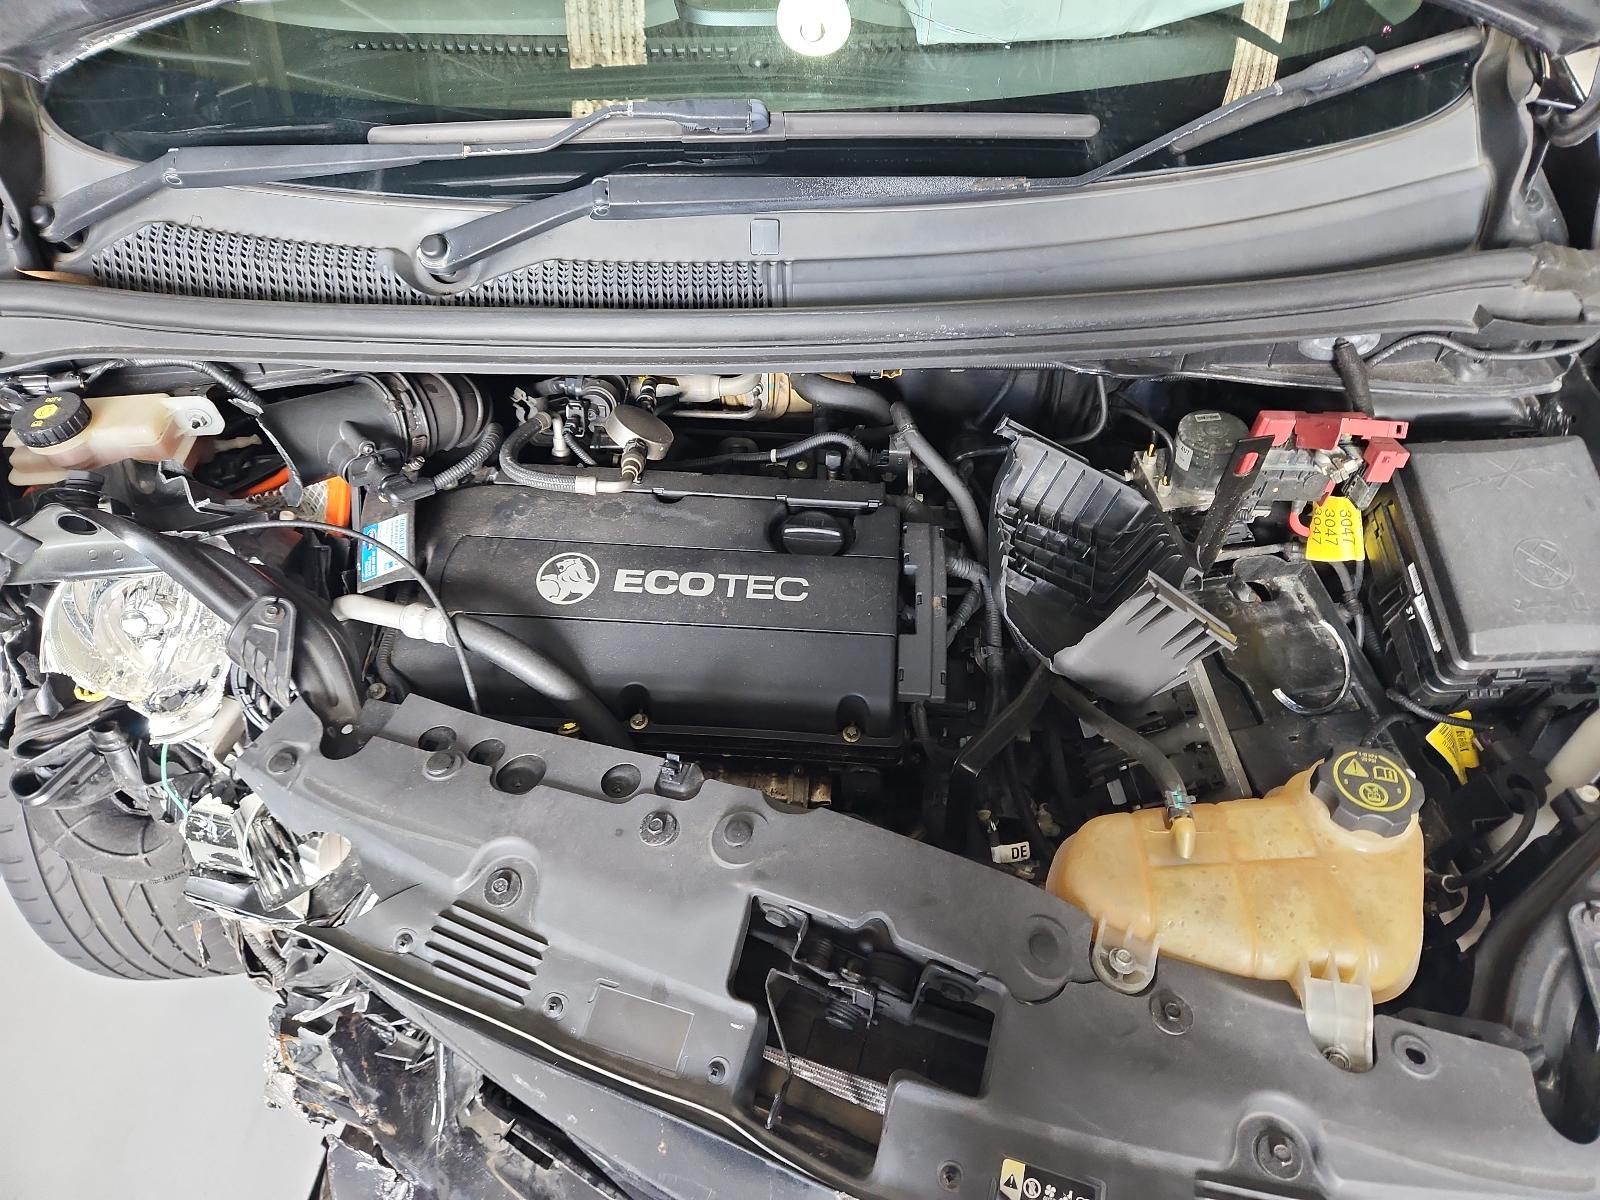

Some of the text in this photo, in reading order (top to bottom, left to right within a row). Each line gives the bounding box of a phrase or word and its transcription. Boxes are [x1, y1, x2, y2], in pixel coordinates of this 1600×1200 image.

[1312, 508, 1322, 545] 3047
[1325, 509, 1338, 545] 3047
[1340, 509, 1355, 545] 3047
[613, 568, 809, 602] ECOTEC
[1011, 845, 1028, 859] DE
